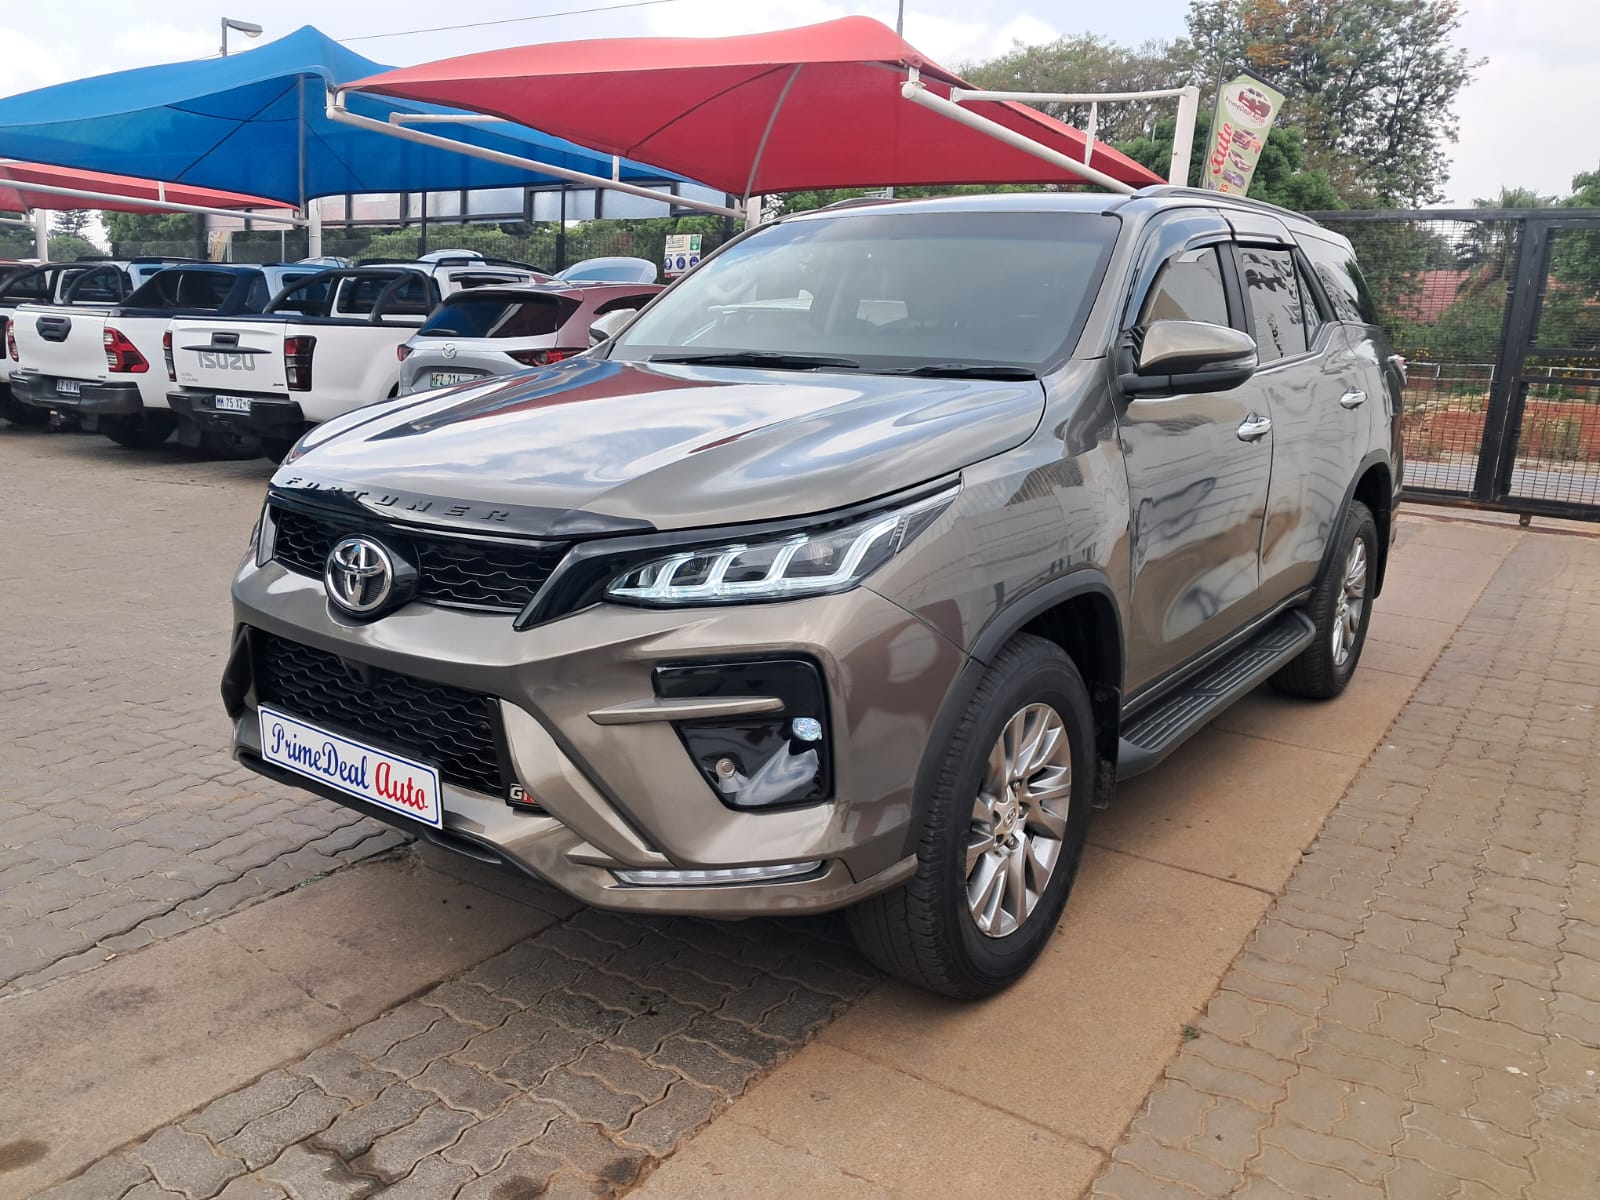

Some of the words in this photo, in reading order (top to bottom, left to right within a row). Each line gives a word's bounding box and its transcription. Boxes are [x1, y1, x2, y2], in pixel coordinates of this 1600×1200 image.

[198, 351, 255, 371] ISUZU
[271, 722, 370, 790] PrimeDeal
[375, 761, 428, 811] Auto
